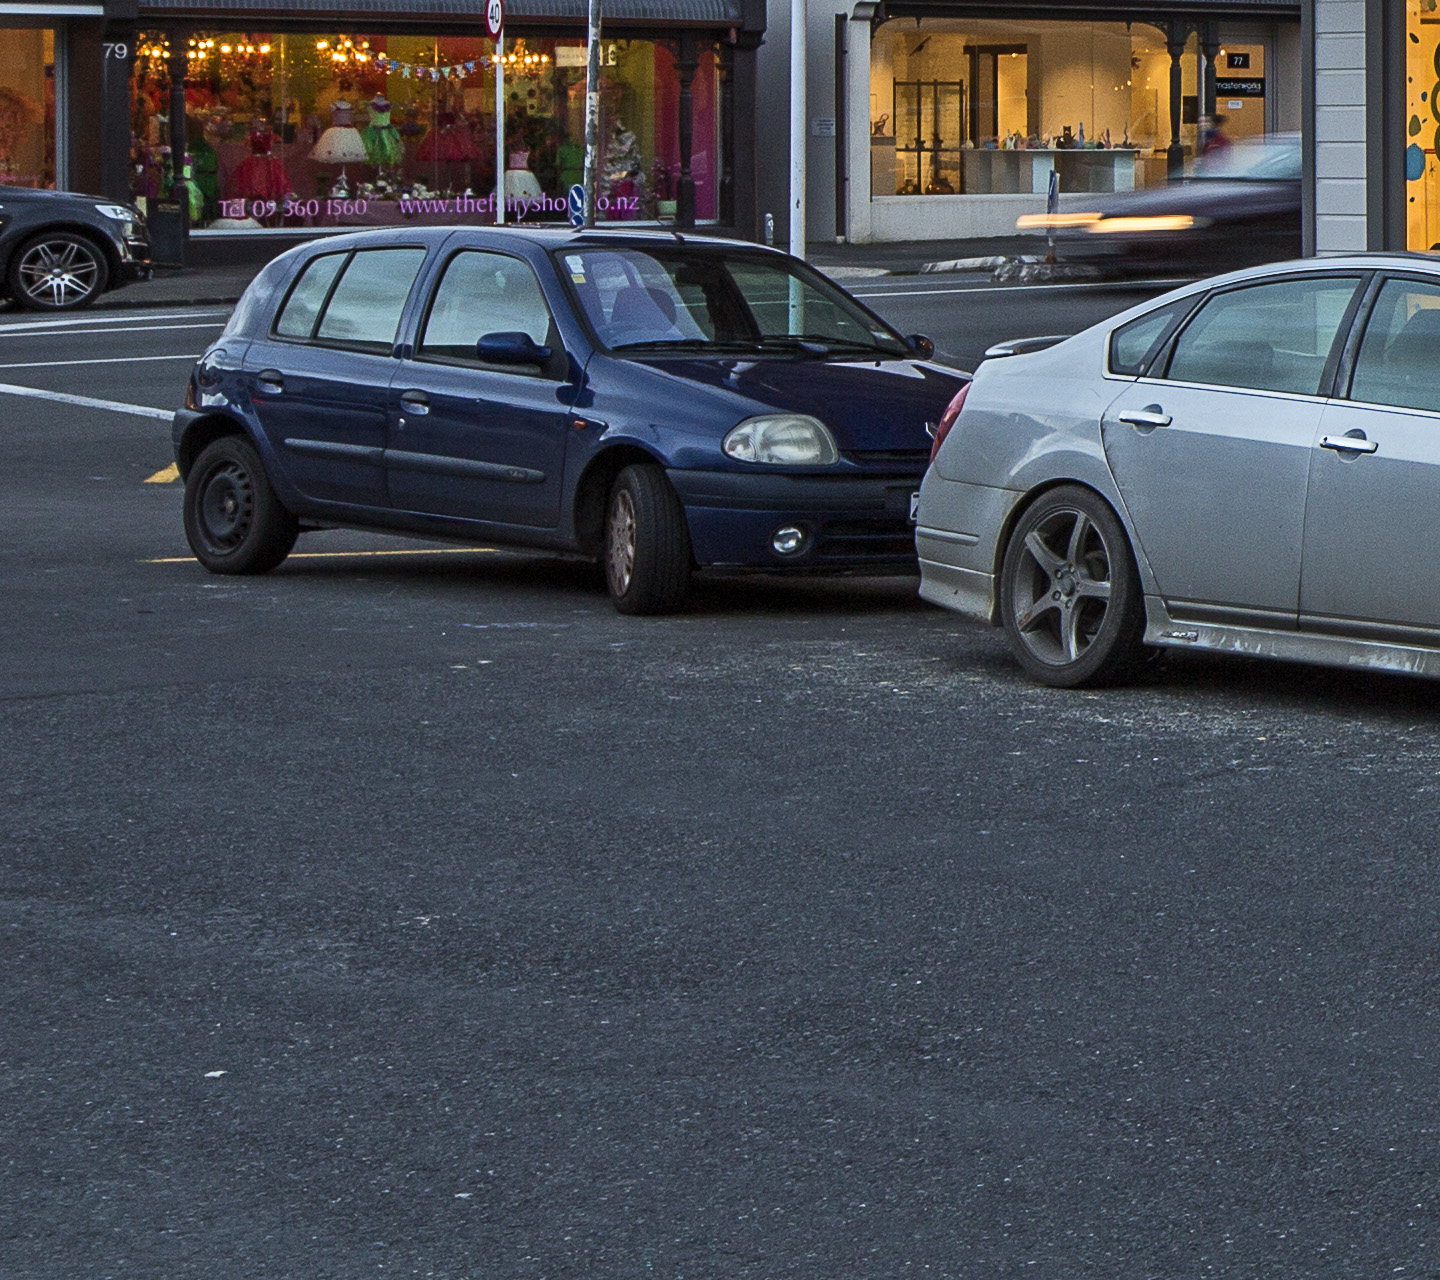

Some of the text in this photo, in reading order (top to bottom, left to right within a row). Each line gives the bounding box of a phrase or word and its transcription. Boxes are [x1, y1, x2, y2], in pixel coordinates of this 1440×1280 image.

[489, 3, 500, 24] 40
[102, 43, 128, 59] 79
[1233, 56, 1243, 66] 77
[218, 197, 368, 218] Tel 09 360 1560
